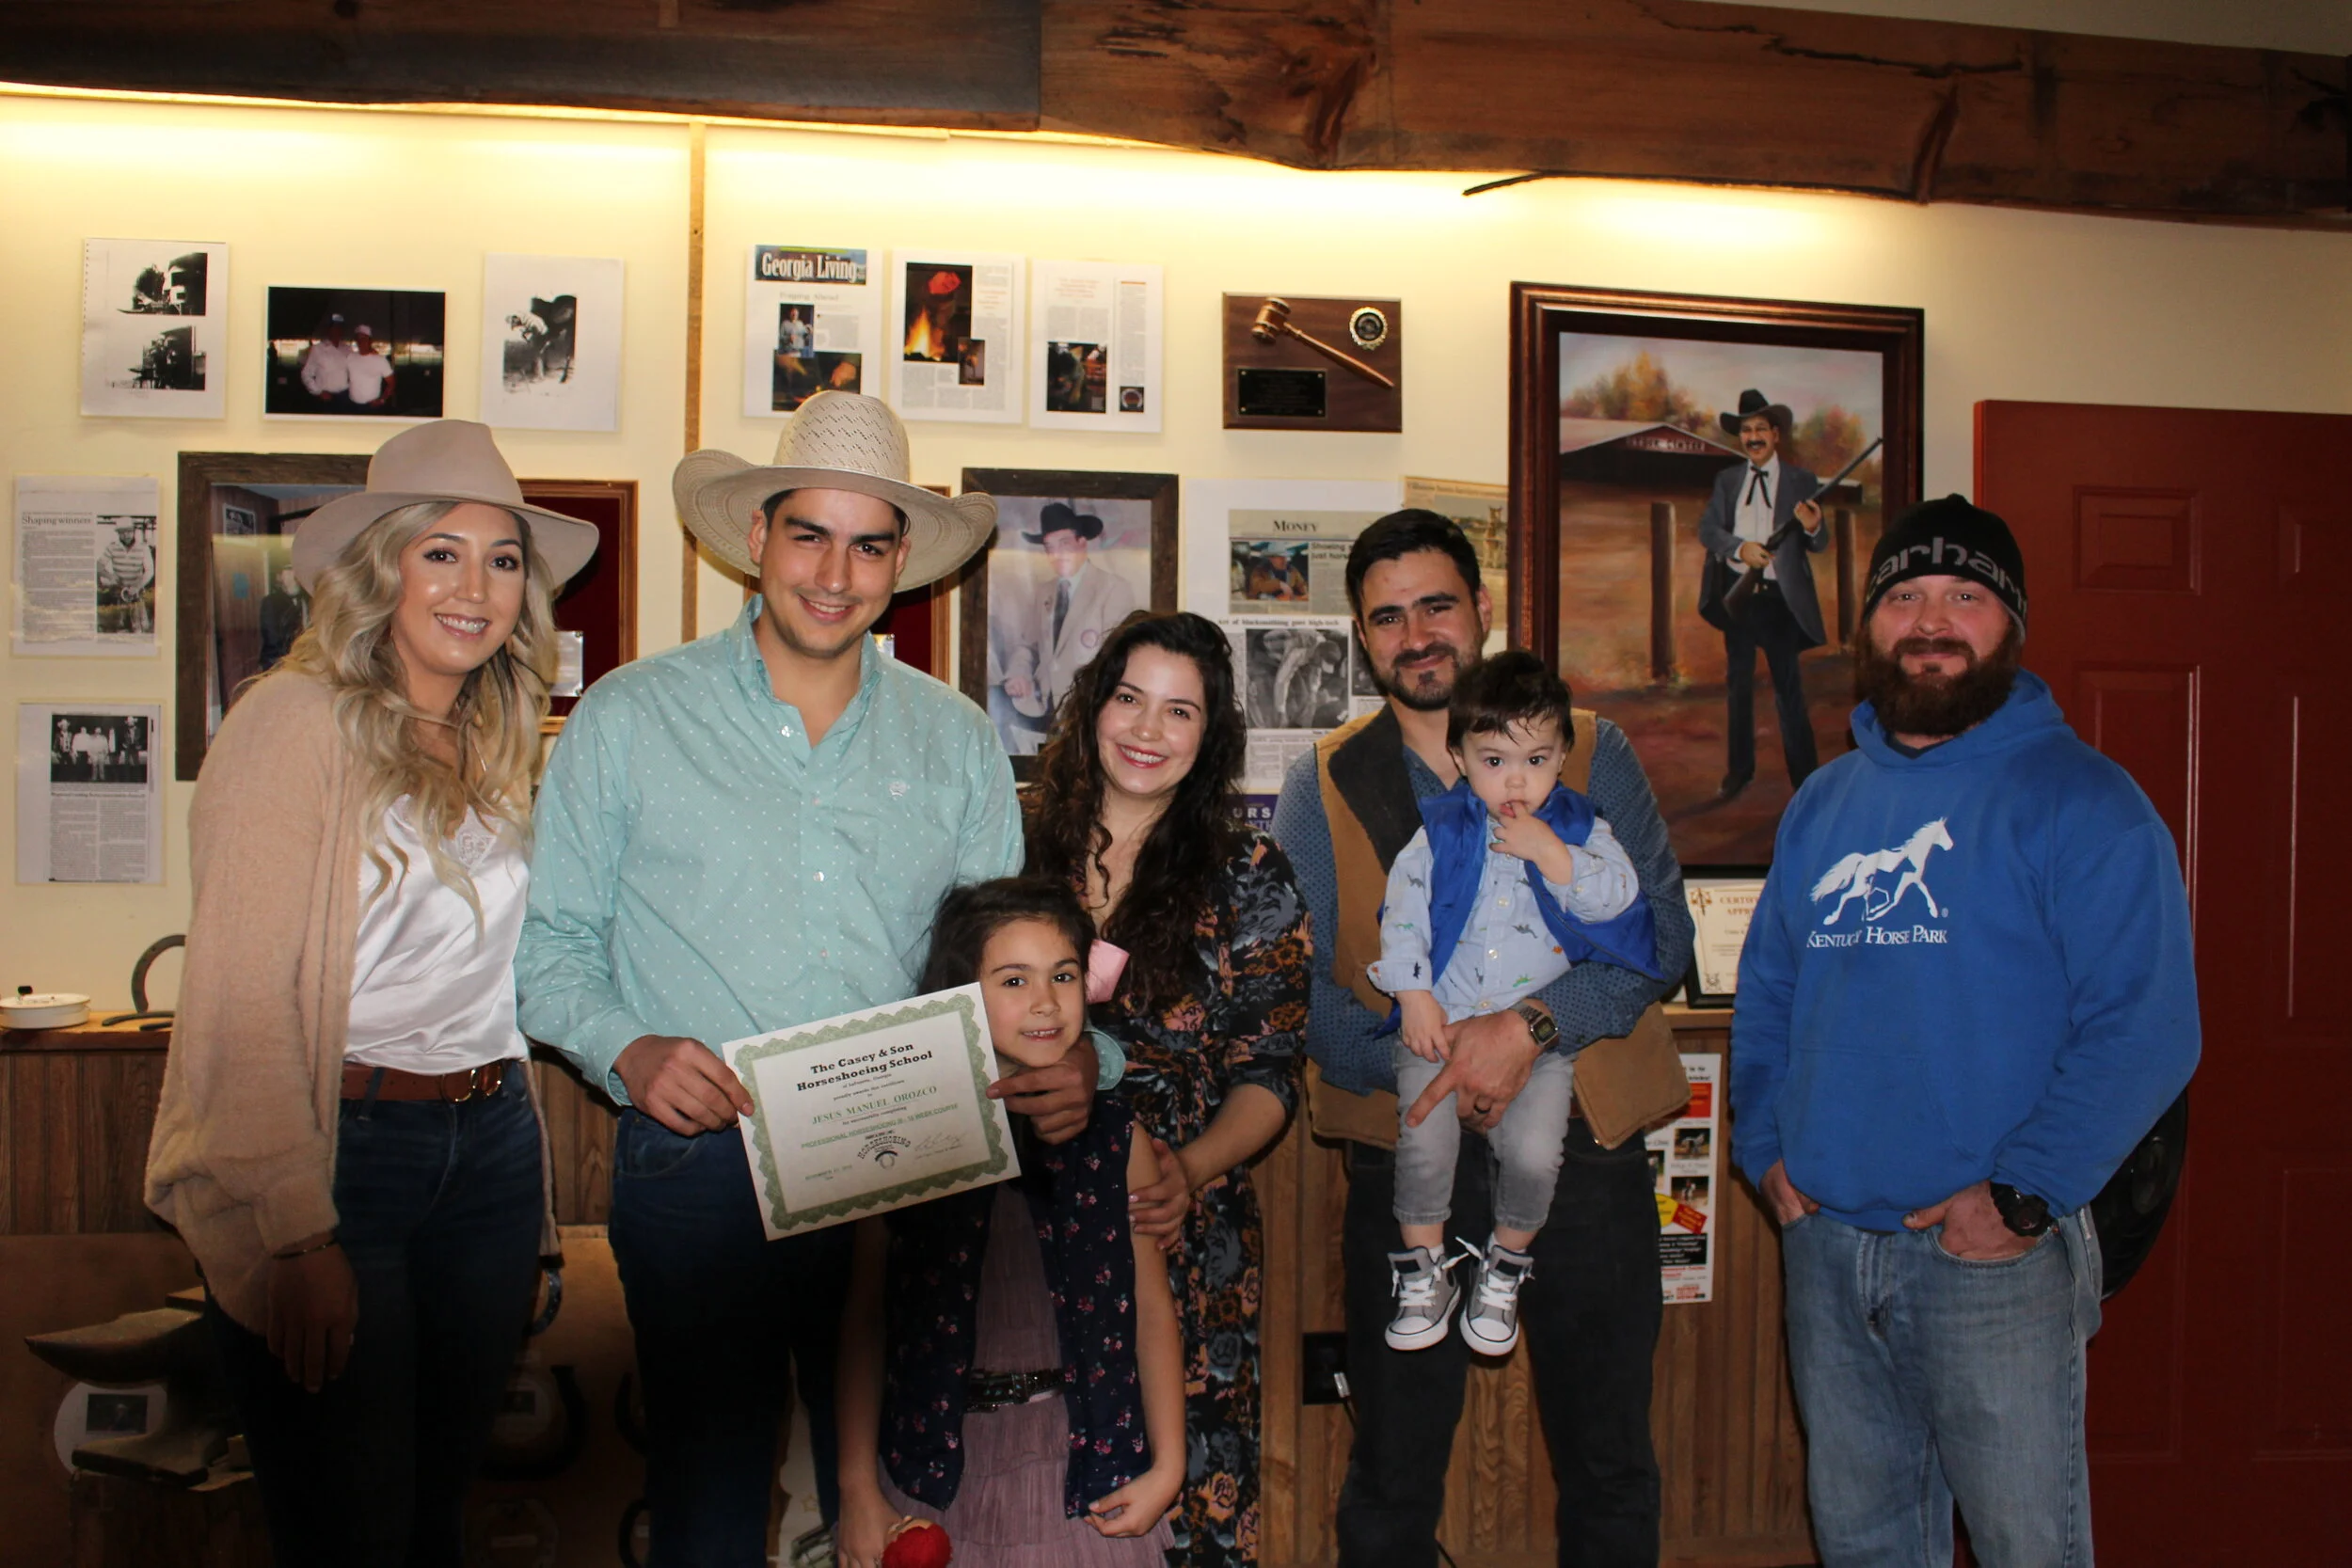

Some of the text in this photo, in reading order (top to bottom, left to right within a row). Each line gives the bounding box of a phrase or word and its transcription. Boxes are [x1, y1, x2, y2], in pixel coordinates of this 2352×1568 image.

[761, 251, 857, 284] Georgia Living
[22, 515, 92, 526] Shaping winners
[1865, 925, 1910, 945] HORSE
[1913, 924, 1948, 944] PARK
[797, 1050, 933, 1091] Horseshoeing School
[810, 1043, 914, 1074] The Casey & Son
[812, 1085, 938, 1125] JESUS MANUEL OROZCO
